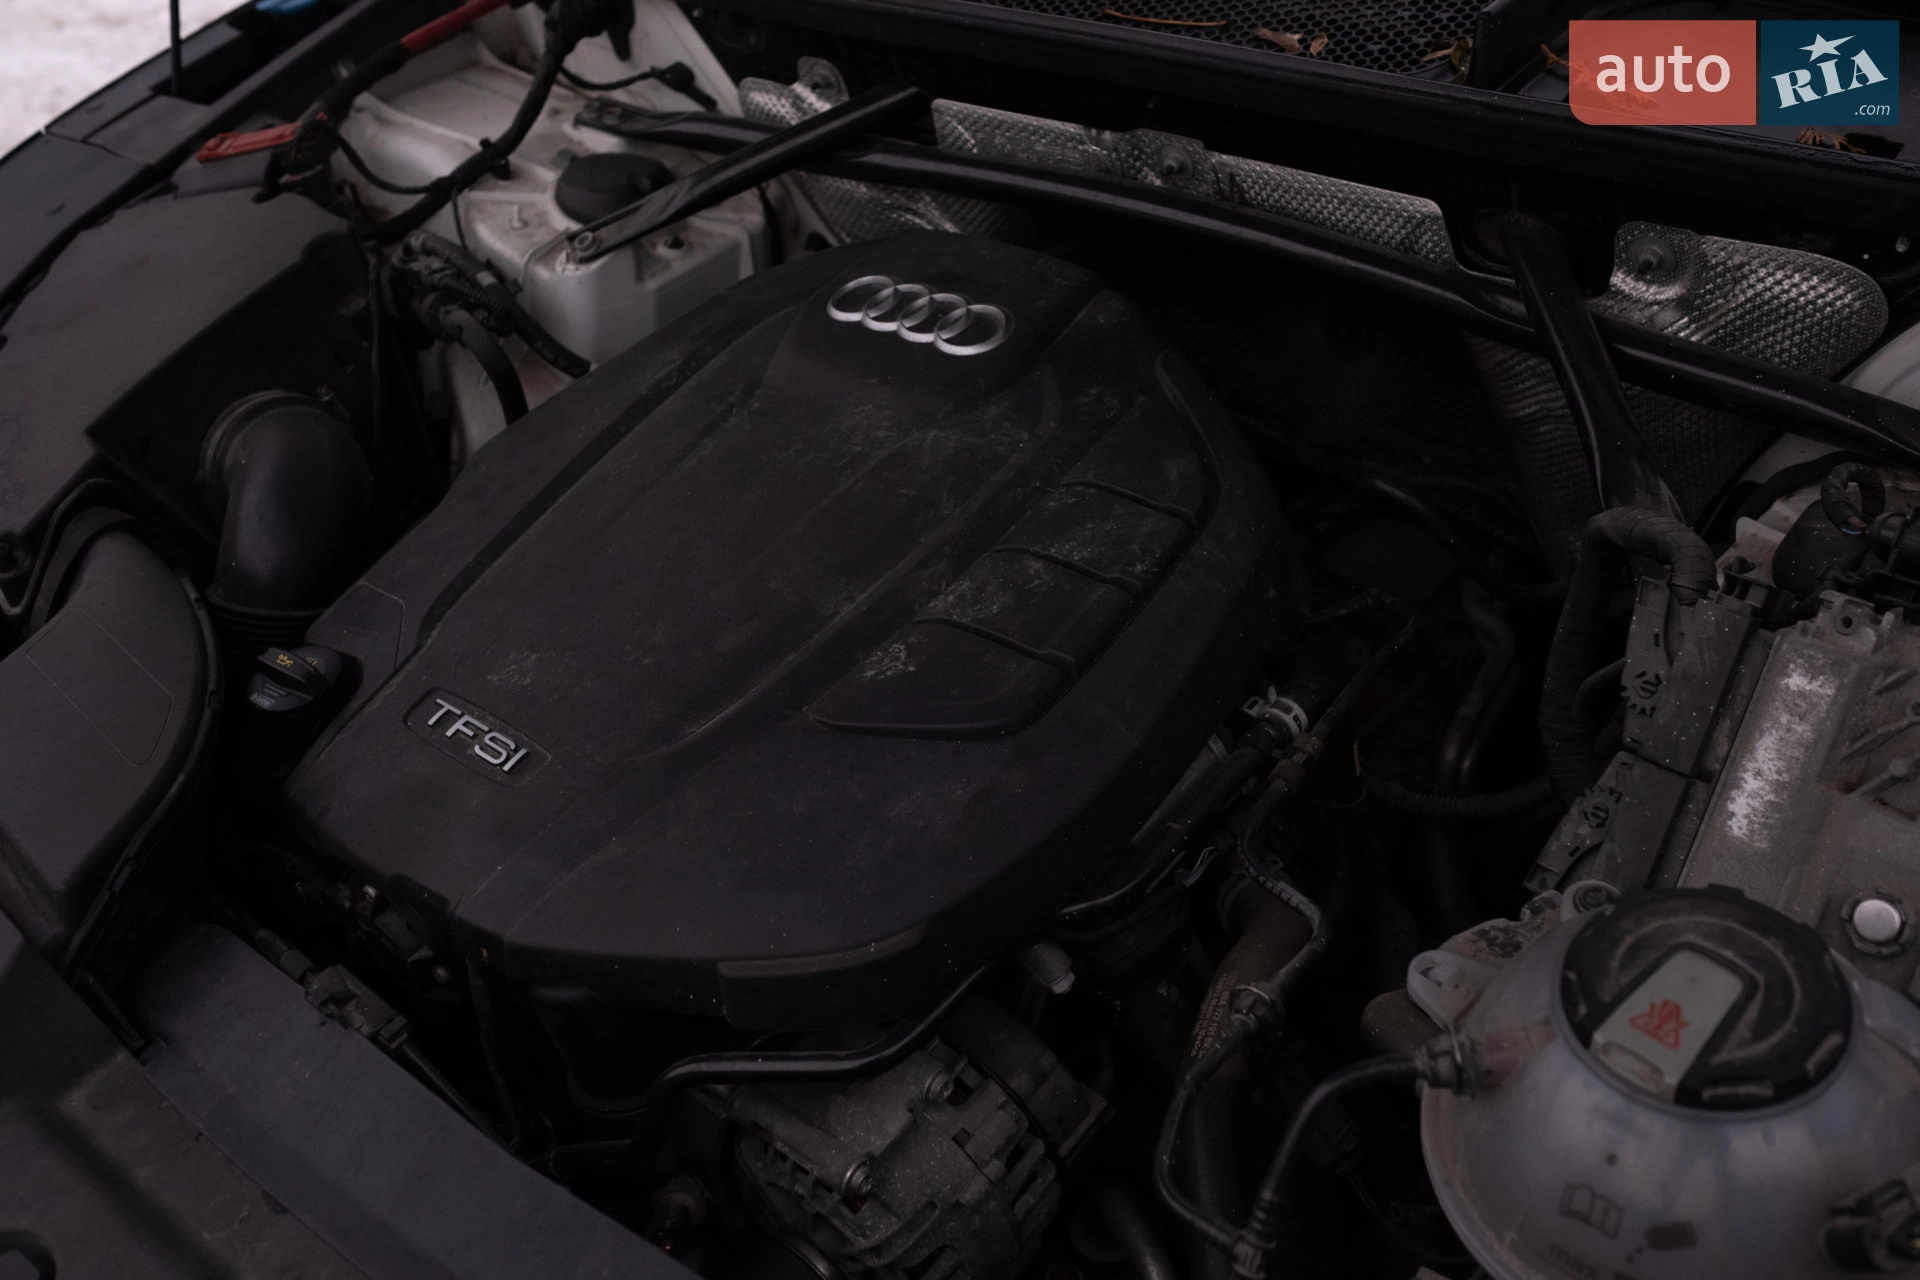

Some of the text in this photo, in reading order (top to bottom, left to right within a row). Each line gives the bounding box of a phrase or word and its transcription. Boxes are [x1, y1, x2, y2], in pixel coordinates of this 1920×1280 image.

[427, 698, 528, 772] TFSI
[1212, 1007, 1223, 1021] 122
[1207, 1021, 1218, 1035] 101
